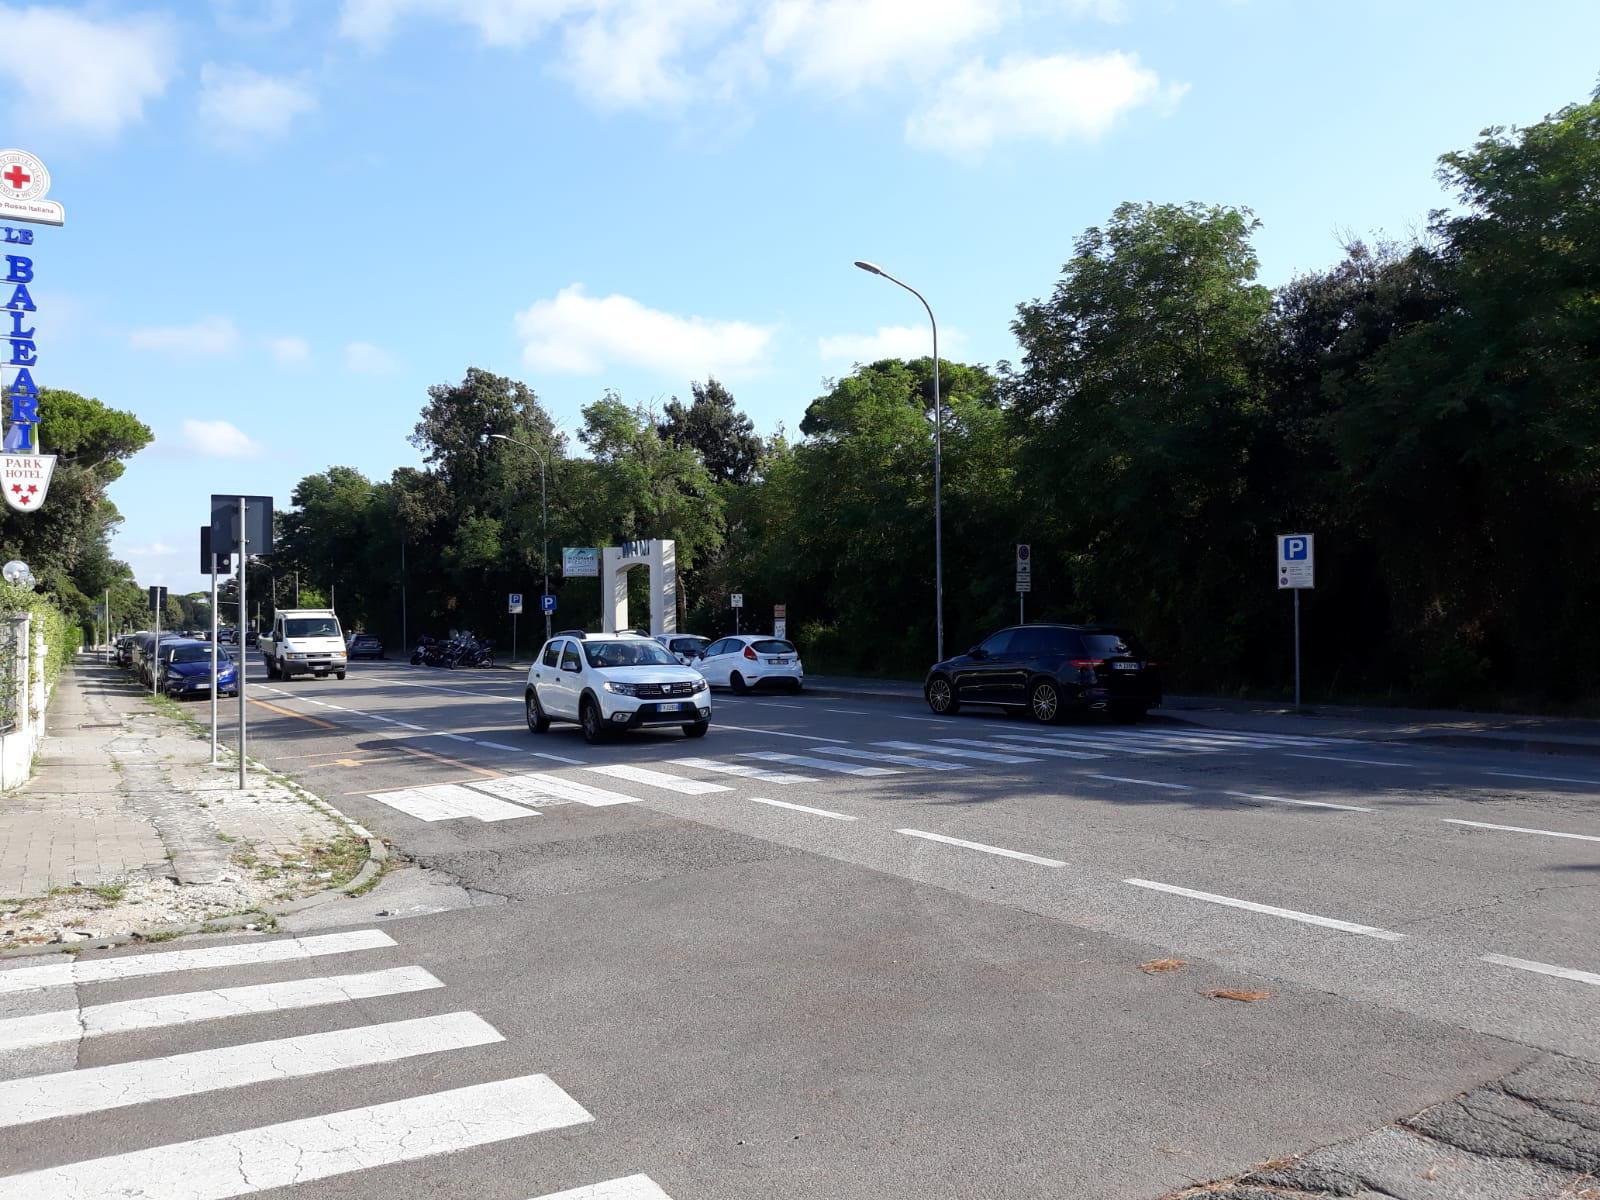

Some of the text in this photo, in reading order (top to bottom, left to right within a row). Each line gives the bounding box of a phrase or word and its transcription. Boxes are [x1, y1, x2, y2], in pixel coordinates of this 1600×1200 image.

[4, 202, 27, 210] Rossa
[28, 205, 54, 214] Italiana
[5, 227, 34, 245] LE
[5, 254, 41, 449] BALEARI
[6, 458, 43, 468] PARK
[5, 469, 44, 479] HOTEL
[1289, 539, 1304, 558] P
[544, 597, 553, 608] P
